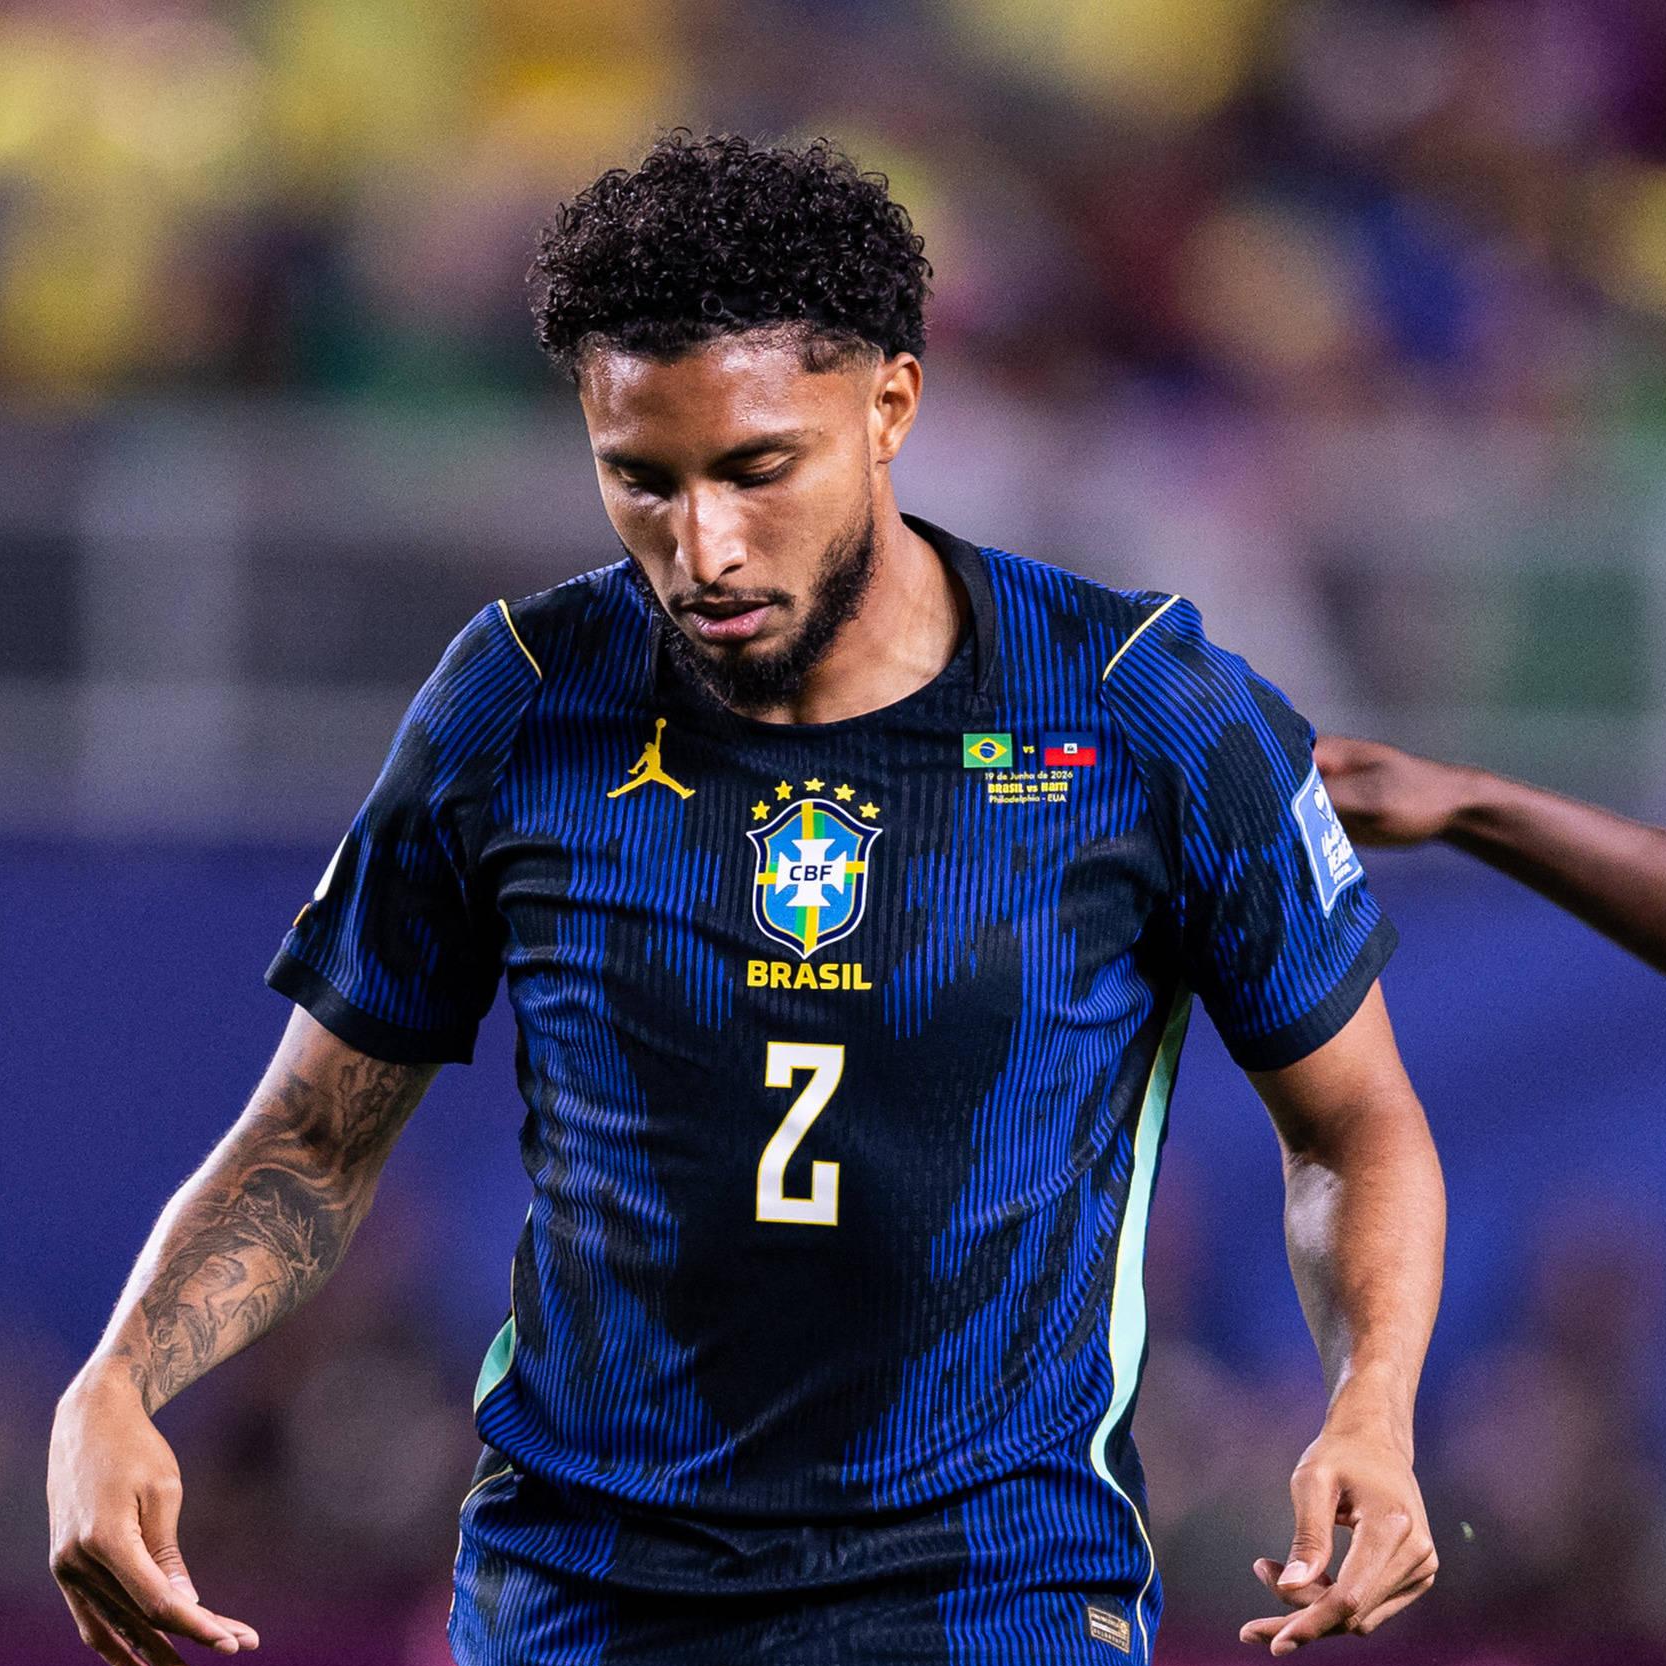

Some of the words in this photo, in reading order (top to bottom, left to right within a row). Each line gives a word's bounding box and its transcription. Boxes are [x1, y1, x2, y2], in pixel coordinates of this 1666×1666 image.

[1022, 746, 1035, 754] vs
[997, 771, 1008, 780] de
[1010, 771, 1035, 780] Junho
[1037, 770, 1048, 779] de
[1050, 770, 1074, 779] 2026
[1026, 784, 1038, 793] vs
[989, 794, 1040, 804] Philadelphia
[1047, 793, 1067, 803] EUA
[789, 864, 833, 881] CBF
[747, 960, 872, 990] BRASIL
[755, 1040, 847, 1227] 2
